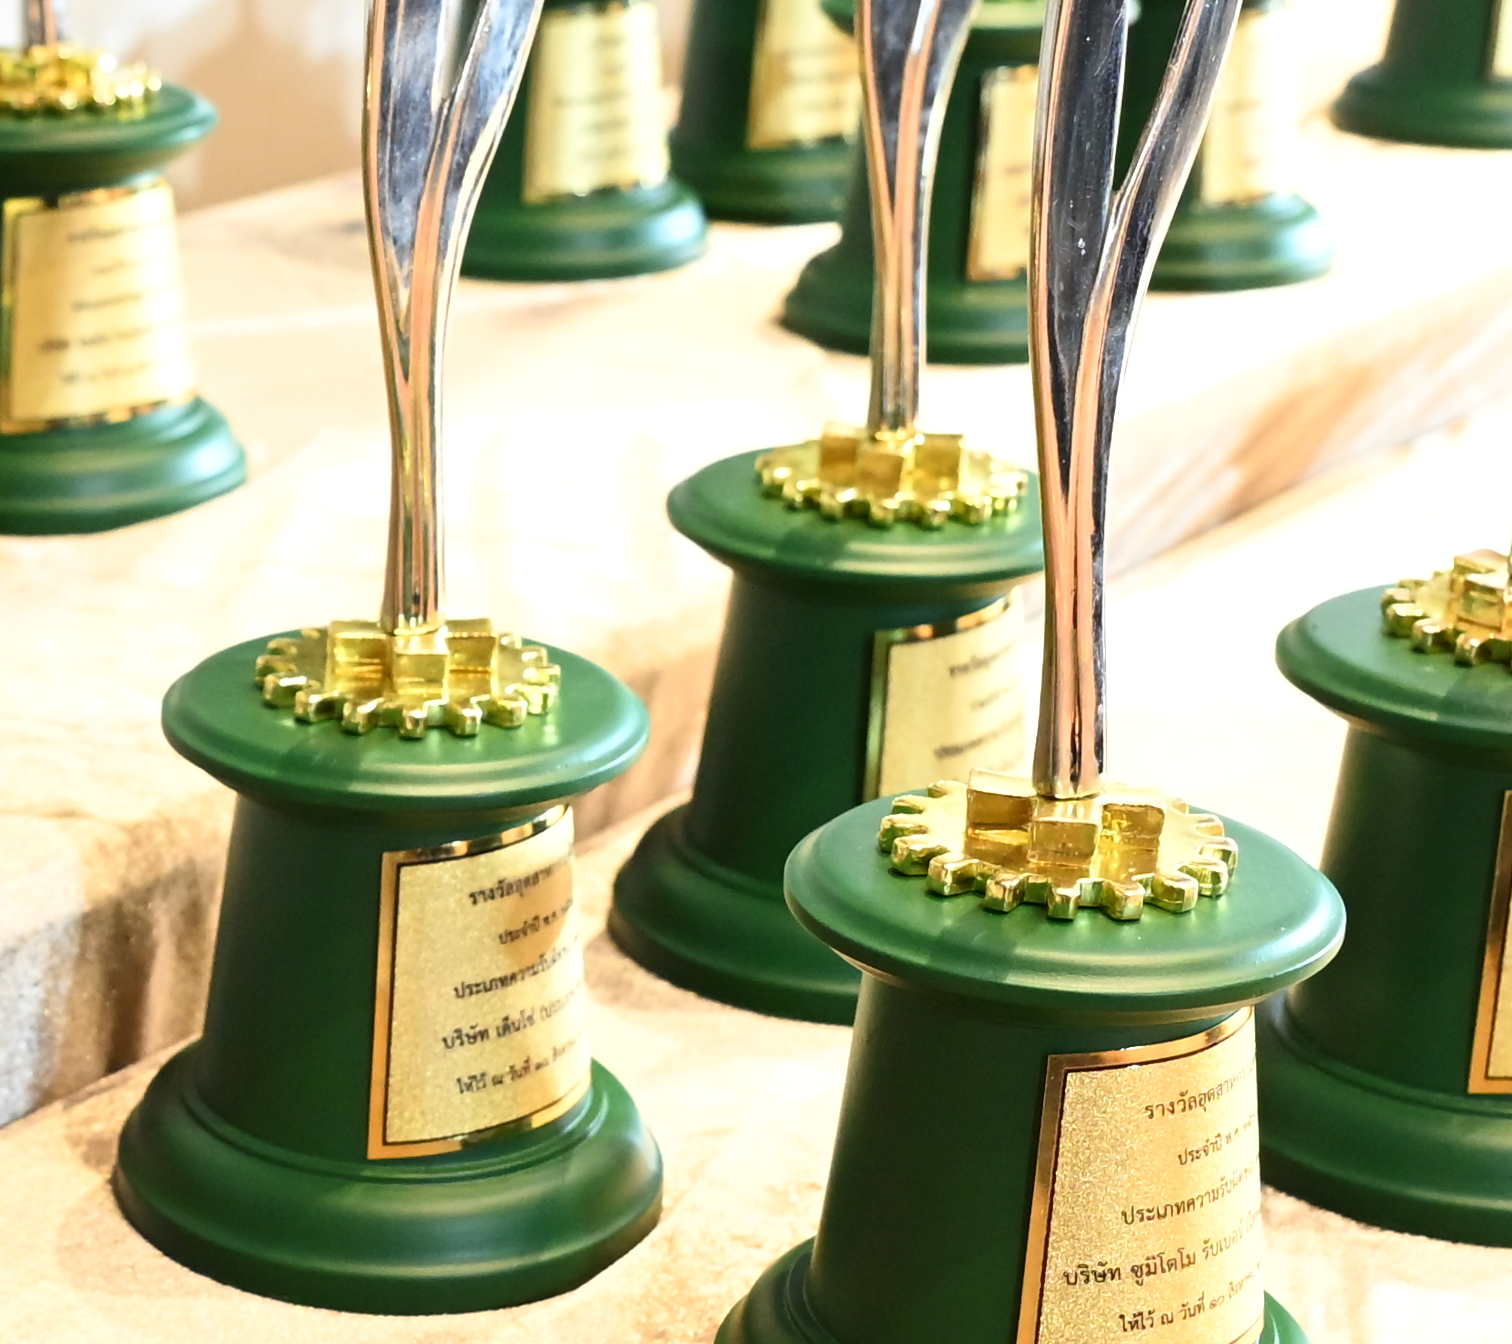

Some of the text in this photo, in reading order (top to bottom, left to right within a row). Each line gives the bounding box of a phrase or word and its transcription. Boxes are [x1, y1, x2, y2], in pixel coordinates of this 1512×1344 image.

[442, 1022, 490, 1051] บริษัท
[1177, 1132, 1223, 1168] ประจำปี
[1062, 1261, 1123, 1288] บริษัท
[1119, 1310, 1155, 1335] ให้ไว้
[1160, 1310, 1175, 1326] ณ
[1180, 1290, 1206, 1322] วันที่
